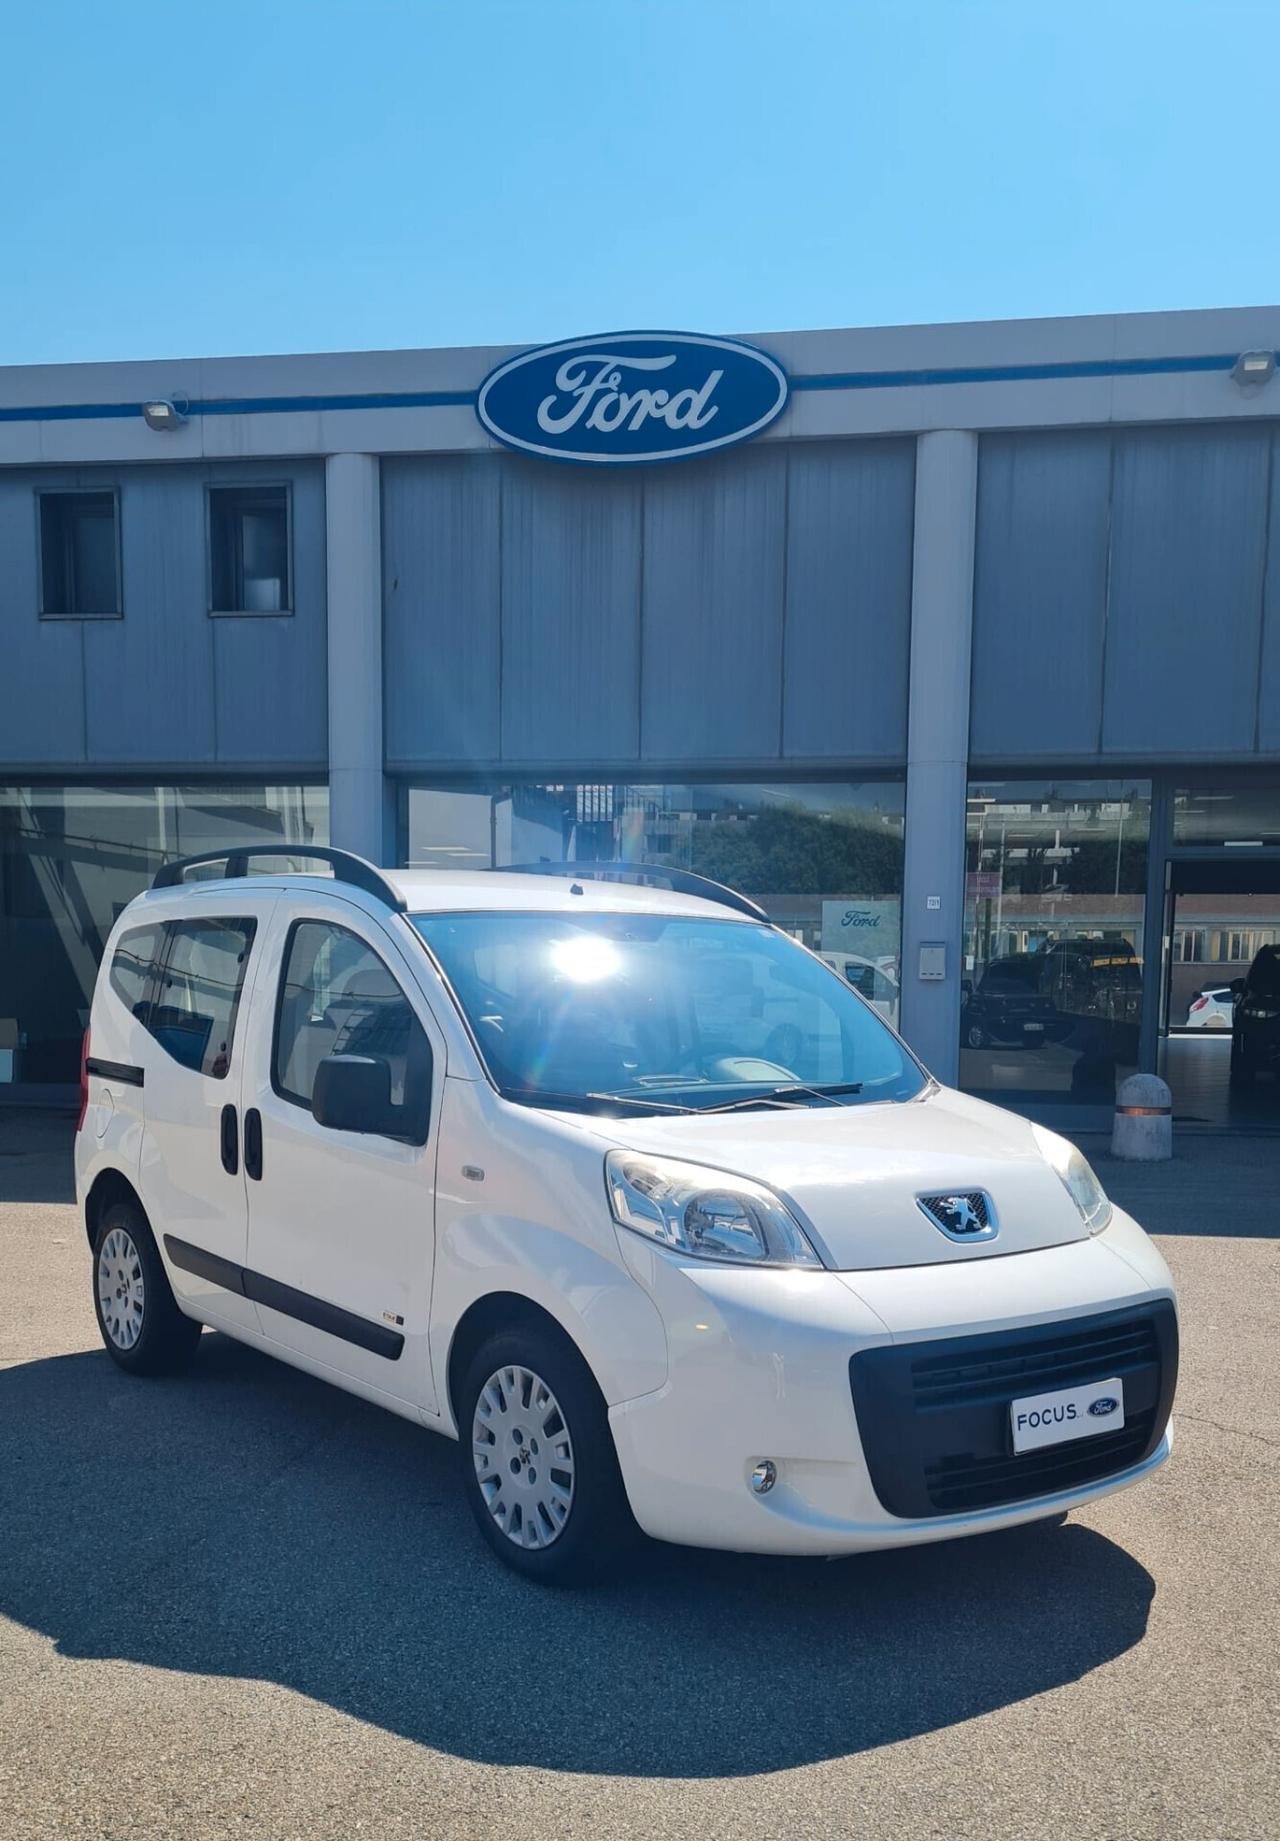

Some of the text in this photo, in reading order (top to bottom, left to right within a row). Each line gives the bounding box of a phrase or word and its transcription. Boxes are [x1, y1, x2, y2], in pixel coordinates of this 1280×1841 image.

[537, 354, 724, 434] Ford
[841, 910, 881, 927] Ford
[1017, 1400, 1113, 1431] FOCUS Ford
